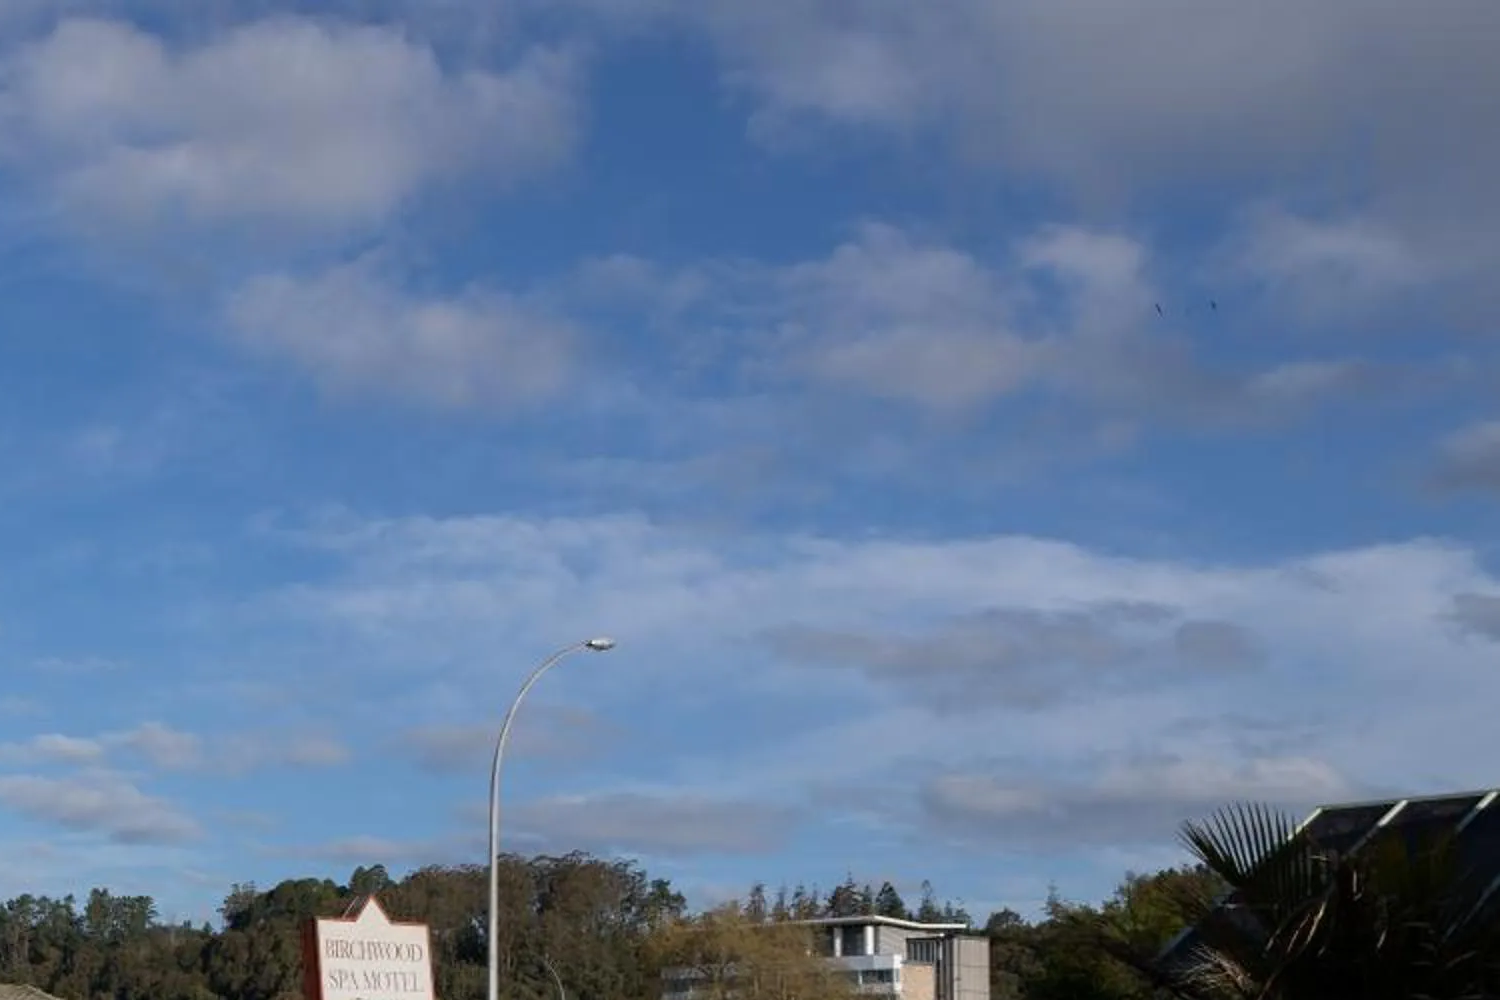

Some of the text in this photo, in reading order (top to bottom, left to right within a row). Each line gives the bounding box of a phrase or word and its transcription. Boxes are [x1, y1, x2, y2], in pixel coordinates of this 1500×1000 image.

[325, 939, 423, 961] BIRCHWOOD
[328, 968, 425, 993] SPA MOTEL
